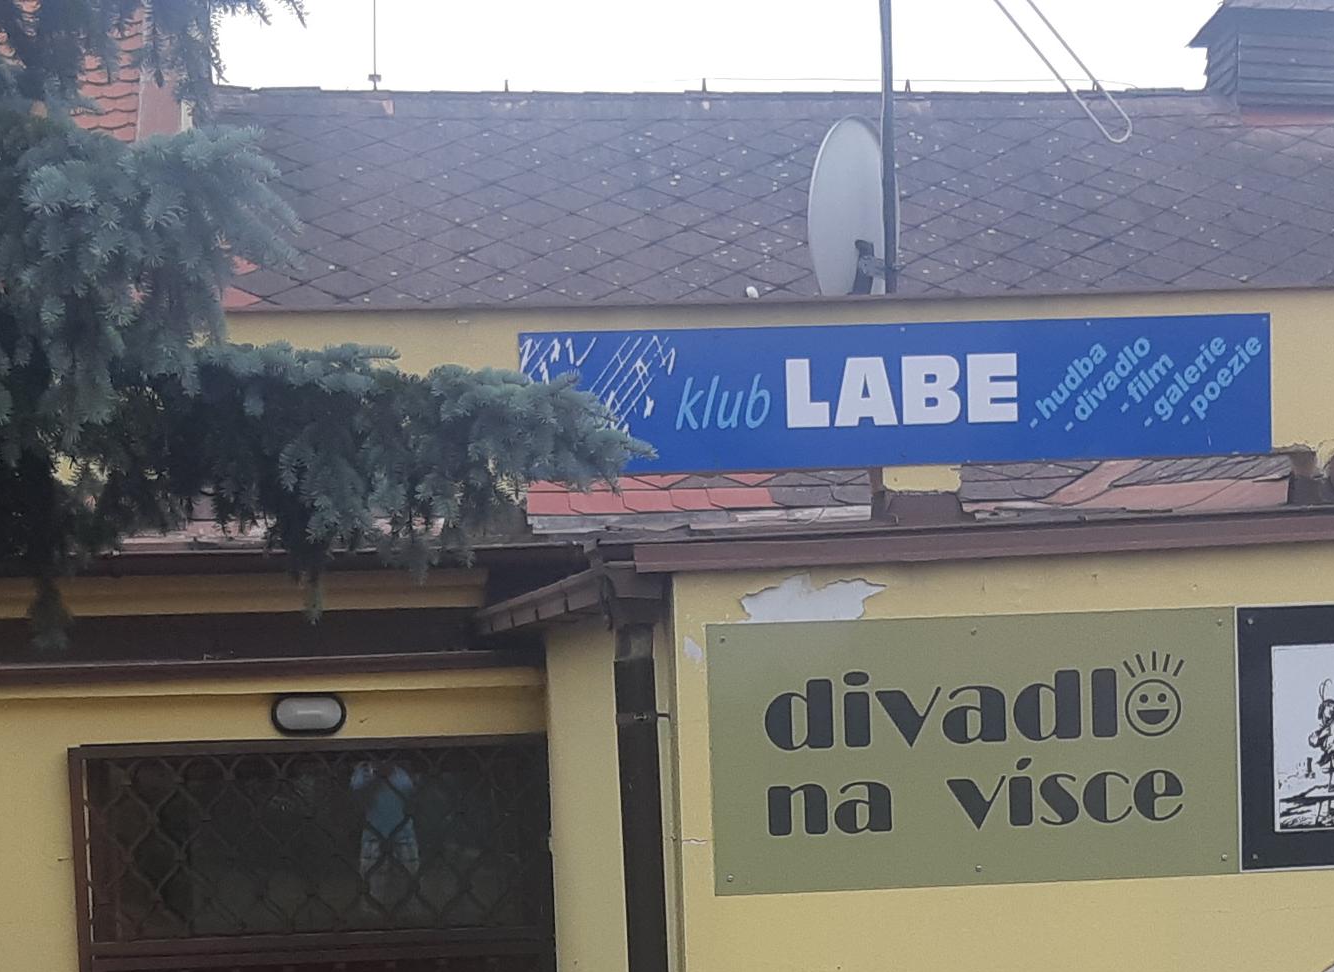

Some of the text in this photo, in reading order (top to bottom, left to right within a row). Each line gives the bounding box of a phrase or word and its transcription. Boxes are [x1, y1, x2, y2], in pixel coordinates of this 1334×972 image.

[675, 353, 1018, 431] klub LABE
[767, 757, 1184, 837] na vísce
